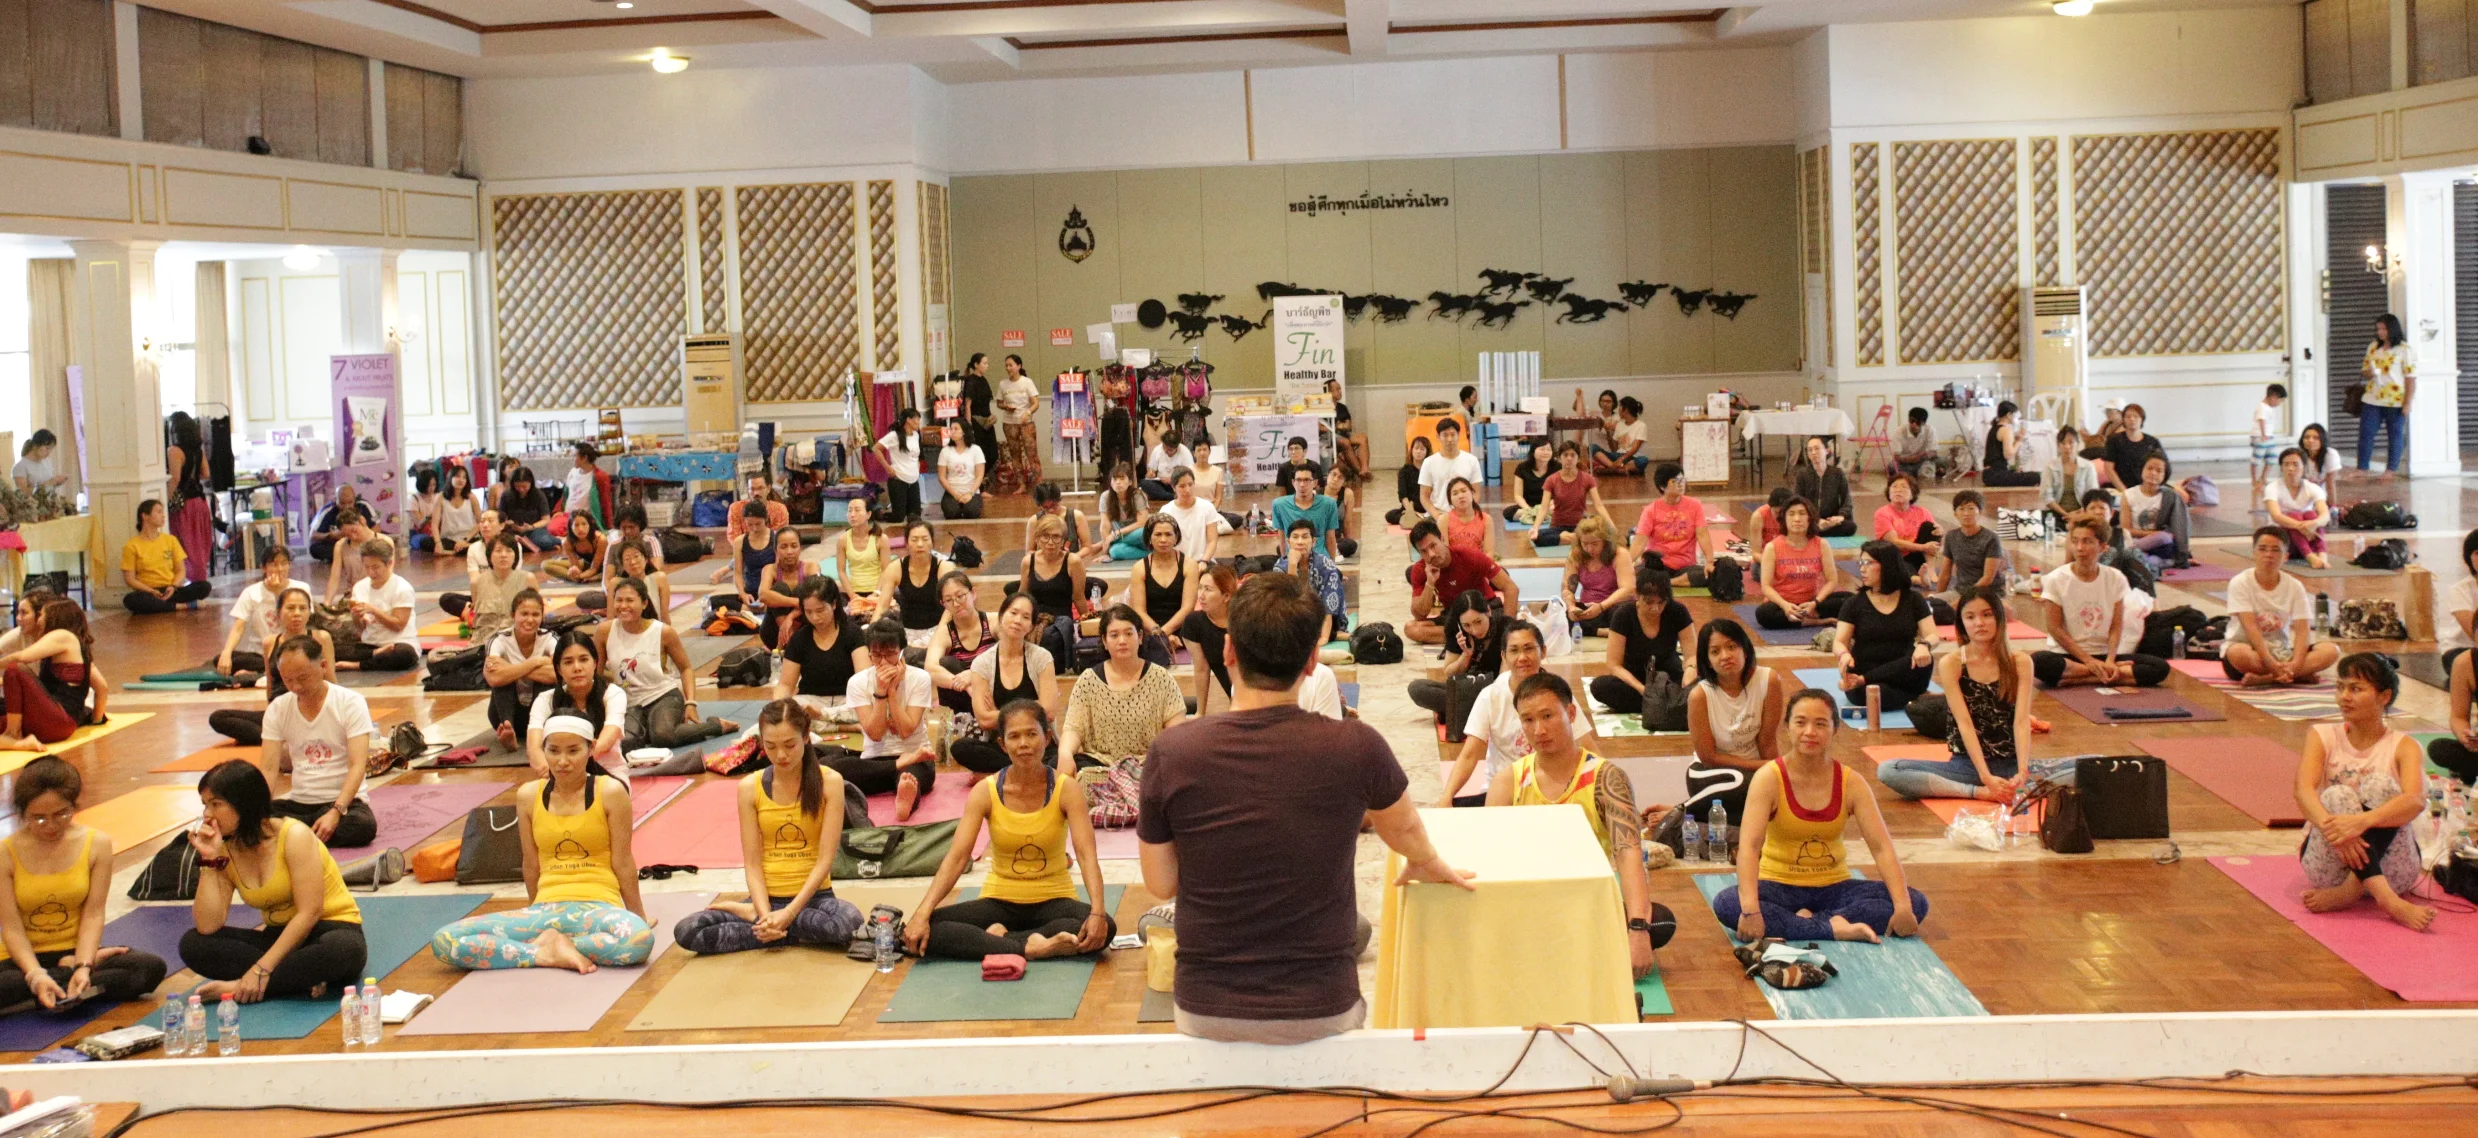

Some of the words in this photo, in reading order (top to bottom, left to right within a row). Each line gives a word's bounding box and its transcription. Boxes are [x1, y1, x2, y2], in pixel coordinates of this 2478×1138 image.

[1004, 331, 1023, 339] SALE
[1051, 329, 1071, 338] SALE
[1284, 331, 1335, 366] Fin
[333, 360, 347, 380] 7
[350, 358, 388, 370] VIOLET
[1284, 370, 1319, 379] Healthy
[1320, 369, 1336, 379] Bar
[1061, 375, 1082, 383] SALE
[1063, 420, 1083, 428] SALE
[1257, 430, 1289, 460] Fi
